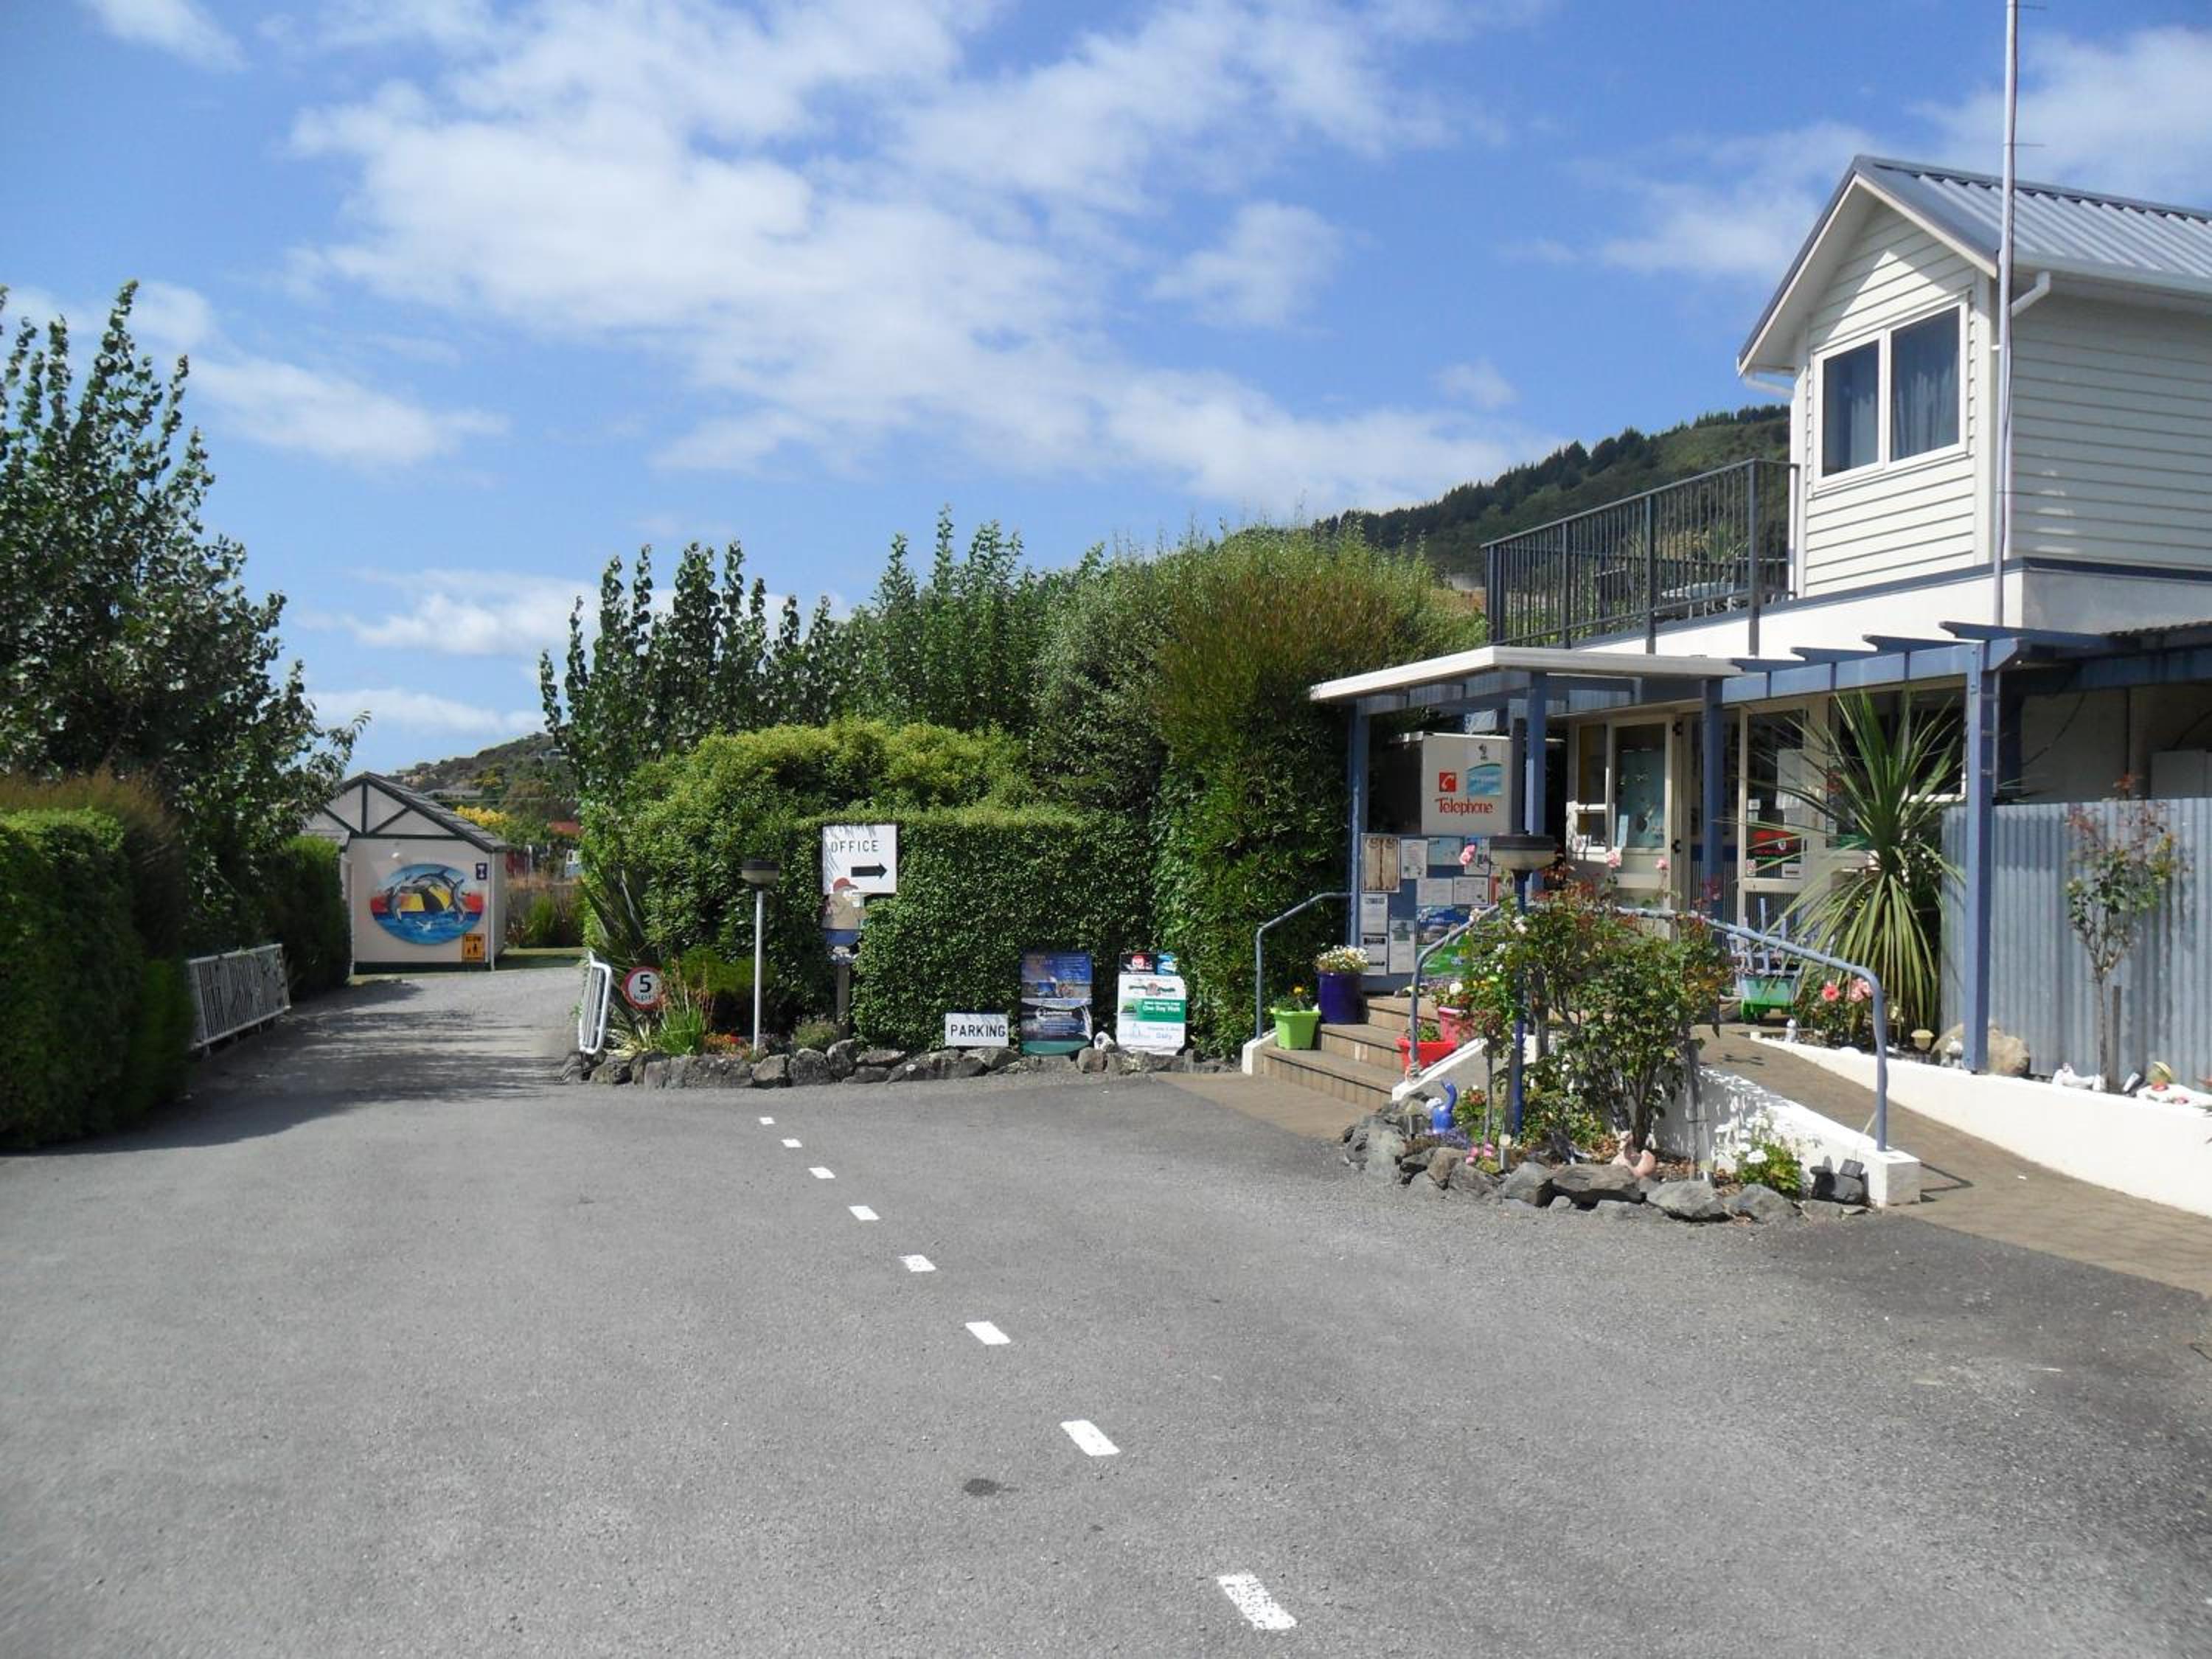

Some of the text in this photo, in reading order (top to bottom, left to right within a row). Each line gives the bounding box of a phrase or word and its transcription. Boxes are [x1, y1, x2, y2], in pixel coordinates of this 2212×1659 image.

[1434, 797, 1493, 816] Telephone
[831, 840, 879, 853] OFFICE
[640, 974, 652, 993] 5
[950, 1024, 1006, 1037] PARKING
